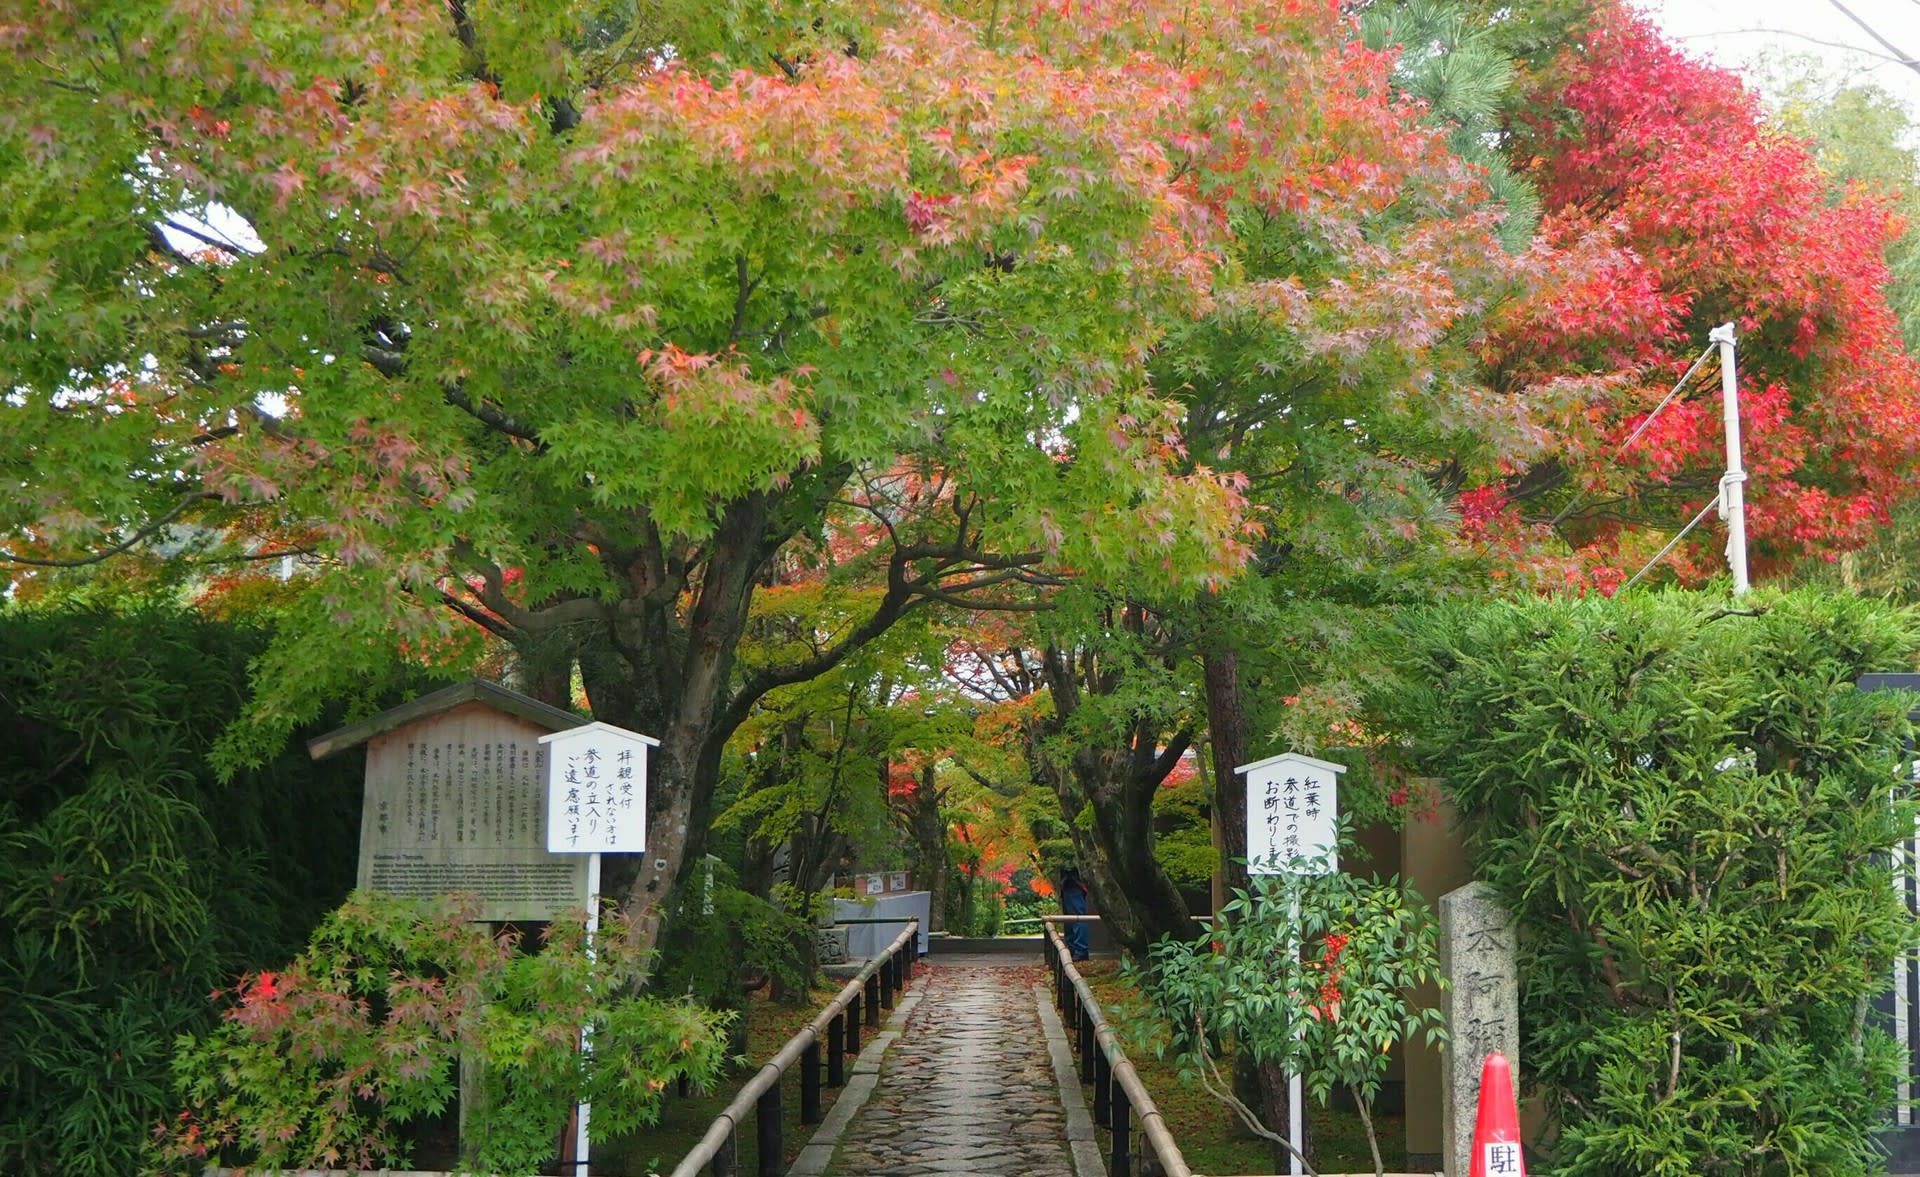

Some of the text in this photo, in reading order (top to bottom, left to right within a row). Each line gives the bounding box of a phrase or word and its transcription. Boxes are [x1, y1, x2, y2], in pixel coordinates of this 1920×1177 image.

[565, 756, 583, 848] ご遠慮願います
[584, 748, 602, 835] 参道の立入り
[605, 783, 617, 845] されない方は
[617, 750, 633, 808] 拝観受付
[1303, 776, 1321, 822] 紅葉時
[1263, 781, 1281, 864] お断わりしま
